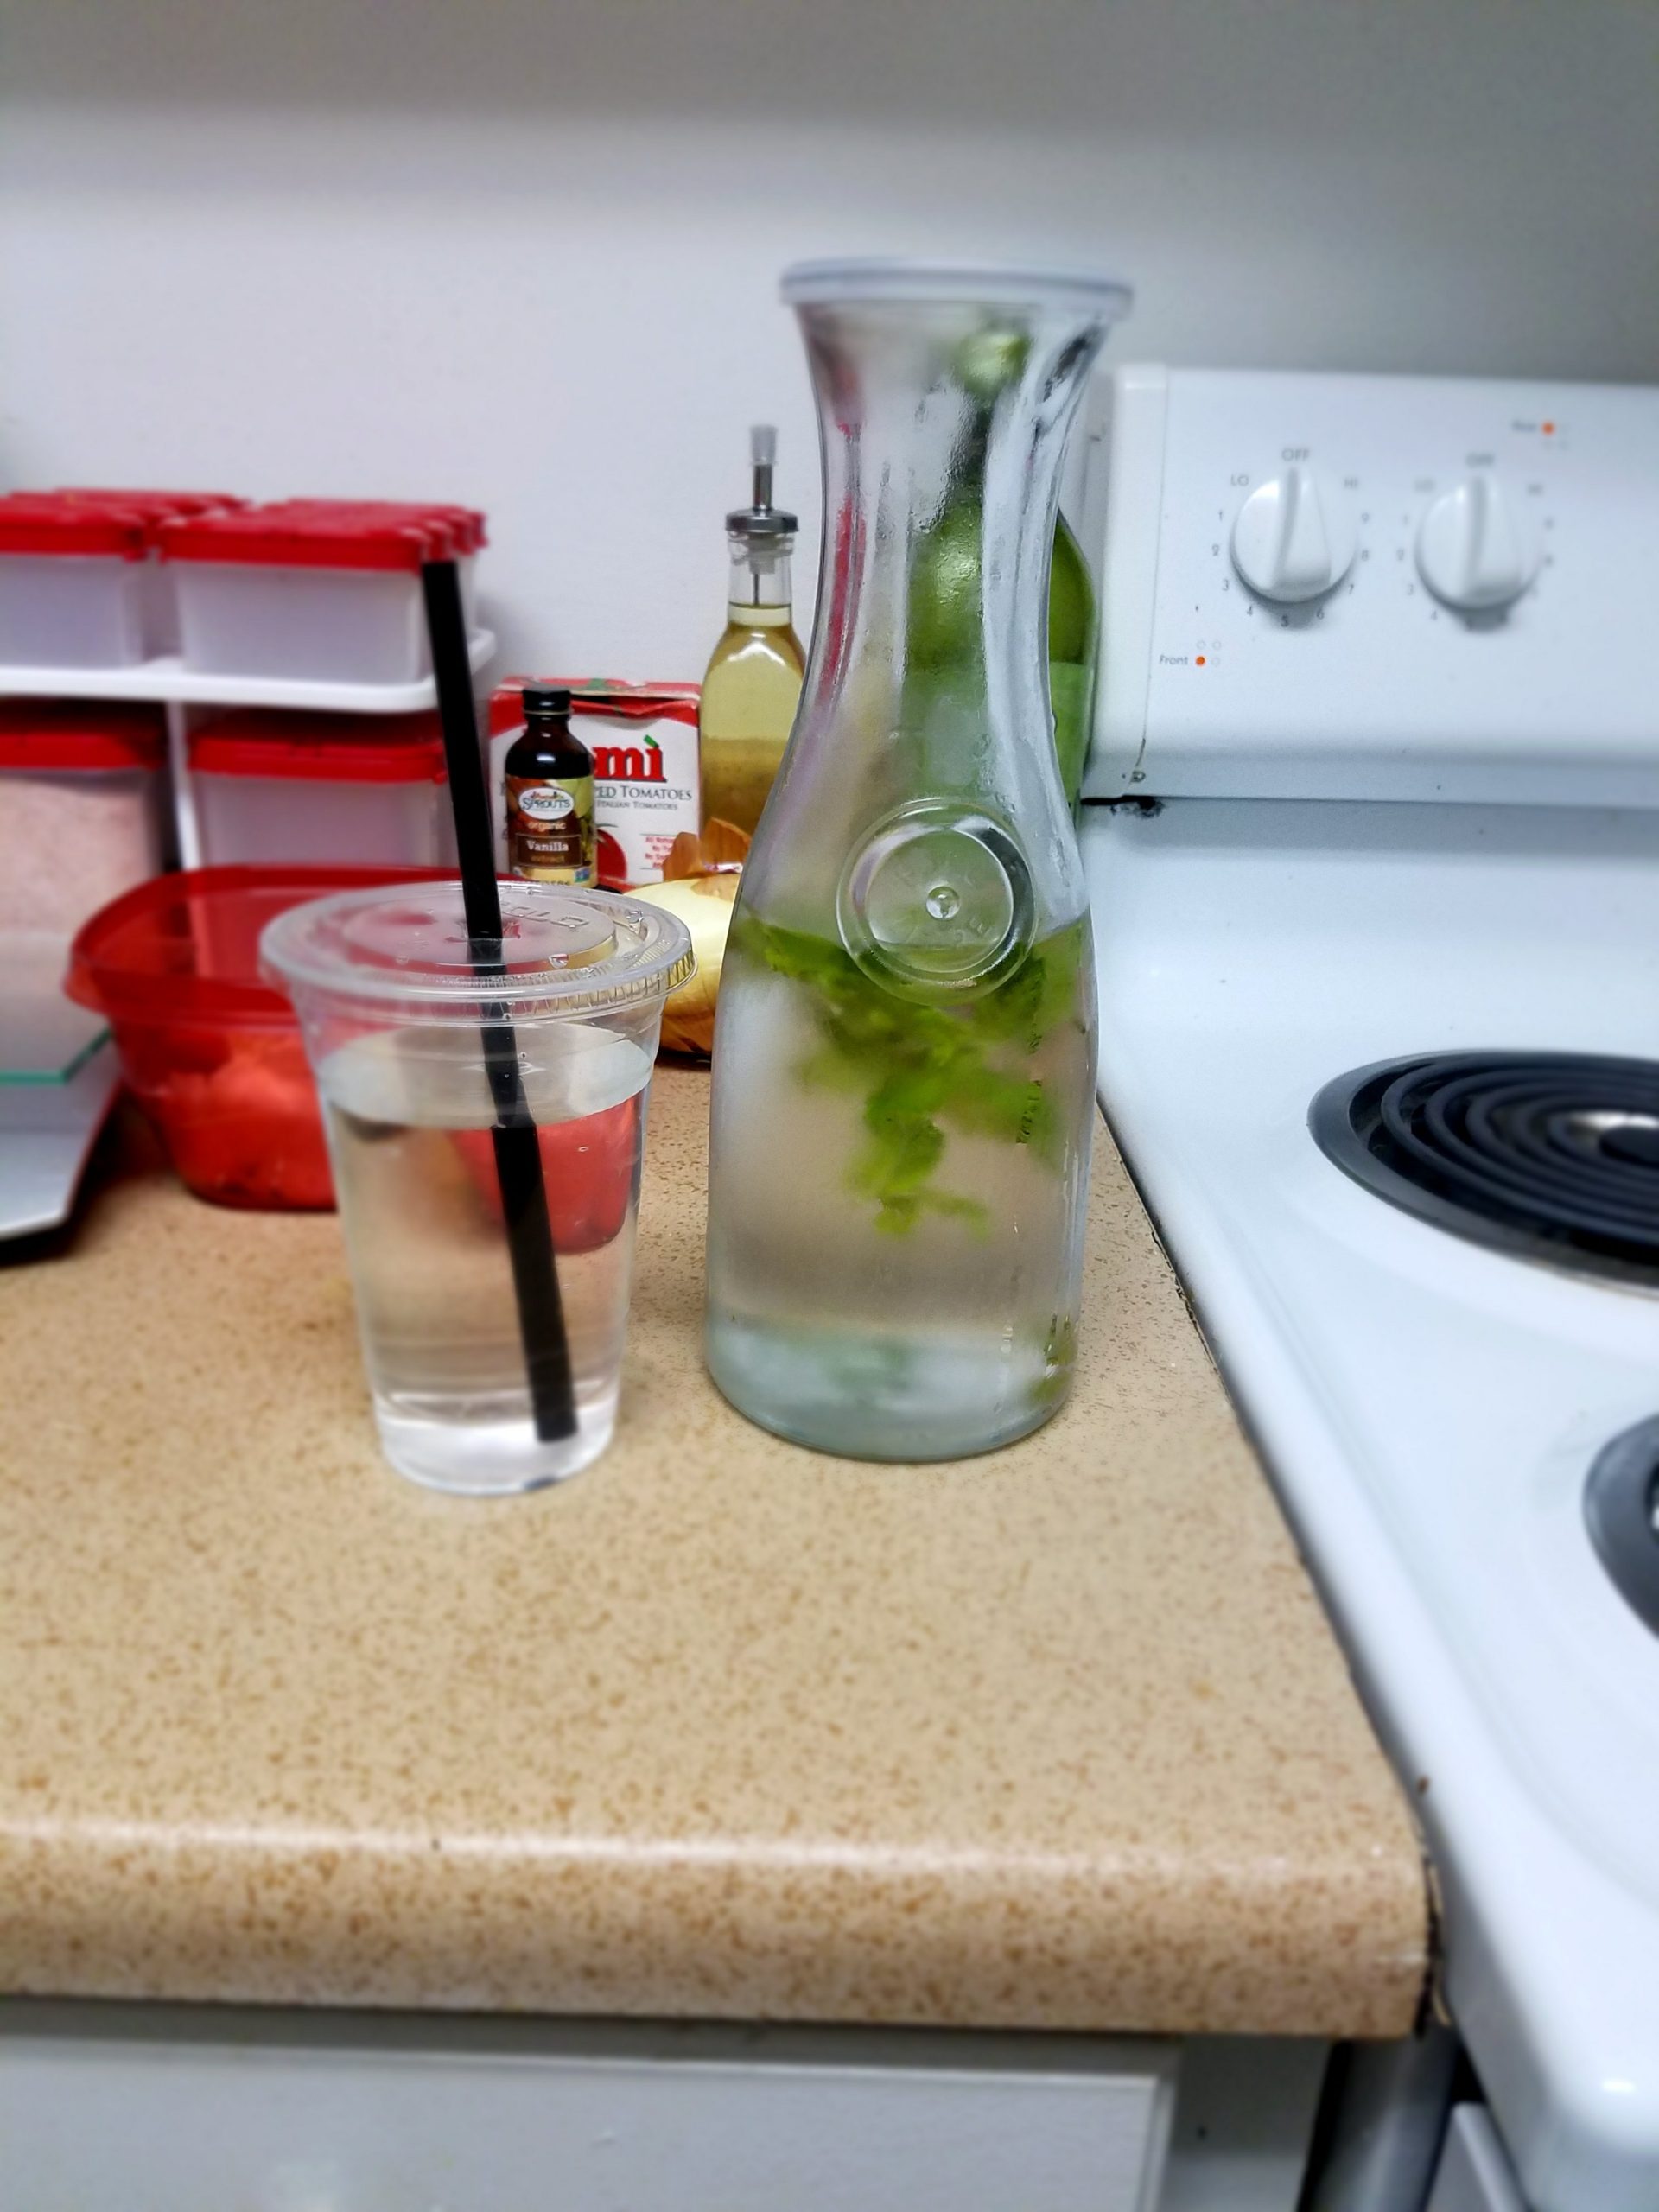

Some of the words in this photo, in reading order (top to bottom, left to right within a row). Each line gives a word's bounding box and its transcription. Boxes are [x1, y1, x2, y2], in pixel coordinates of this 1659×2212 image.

[1282, 448, 1310, 461] OFF
[1230, 475, 1249, 486] LO
[1212, 544, 1220, 556] 2
[1223, 580, 1230, 591] 3
[1246, 606, 1253, 616] 4
[1316, 608, 1325, 620] 6
[1281, 615, 1289, 627] 5
[1160, 655, 1188, 666] Front
[594, 786, 617, 798] ED
[526, 840, 569, 852] Vanilla
